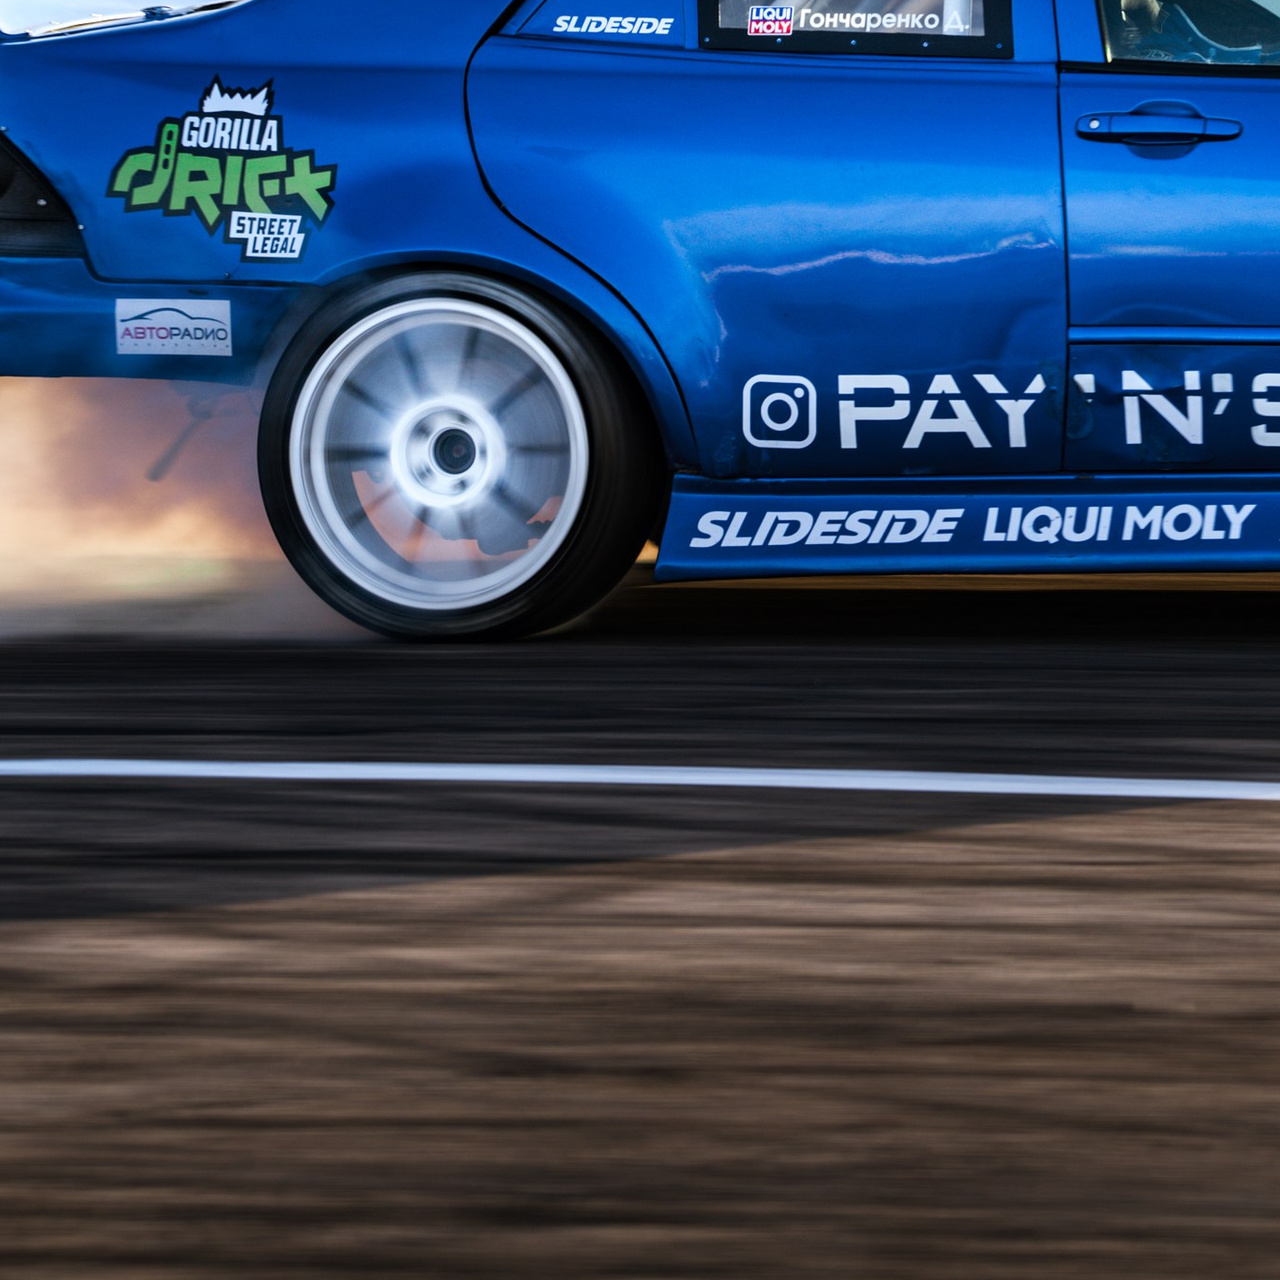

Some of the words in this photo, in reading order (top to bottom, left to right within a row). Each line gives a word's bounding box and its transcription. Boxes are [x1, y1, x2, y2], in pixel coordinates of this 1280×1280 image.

[751, 7, 792, 21] LIQUI
[799, 8, 940, 32] Гончаренко
[943, 10, 971, 32] Д.
[552, 16, 675, 35] SLIDESIDE
[749, 21, 792, 35] MOLY
[181, 116, 278, 151] GORILLA
[235, 216, 297, 236] STREET
[251, 236, 297, 254] LEGAL
[689, 508, 965, 548] SLIDESIDE
[983, 506, 1112, 545] LIQUI
[1121, 503, 1257, 541] MOLY
